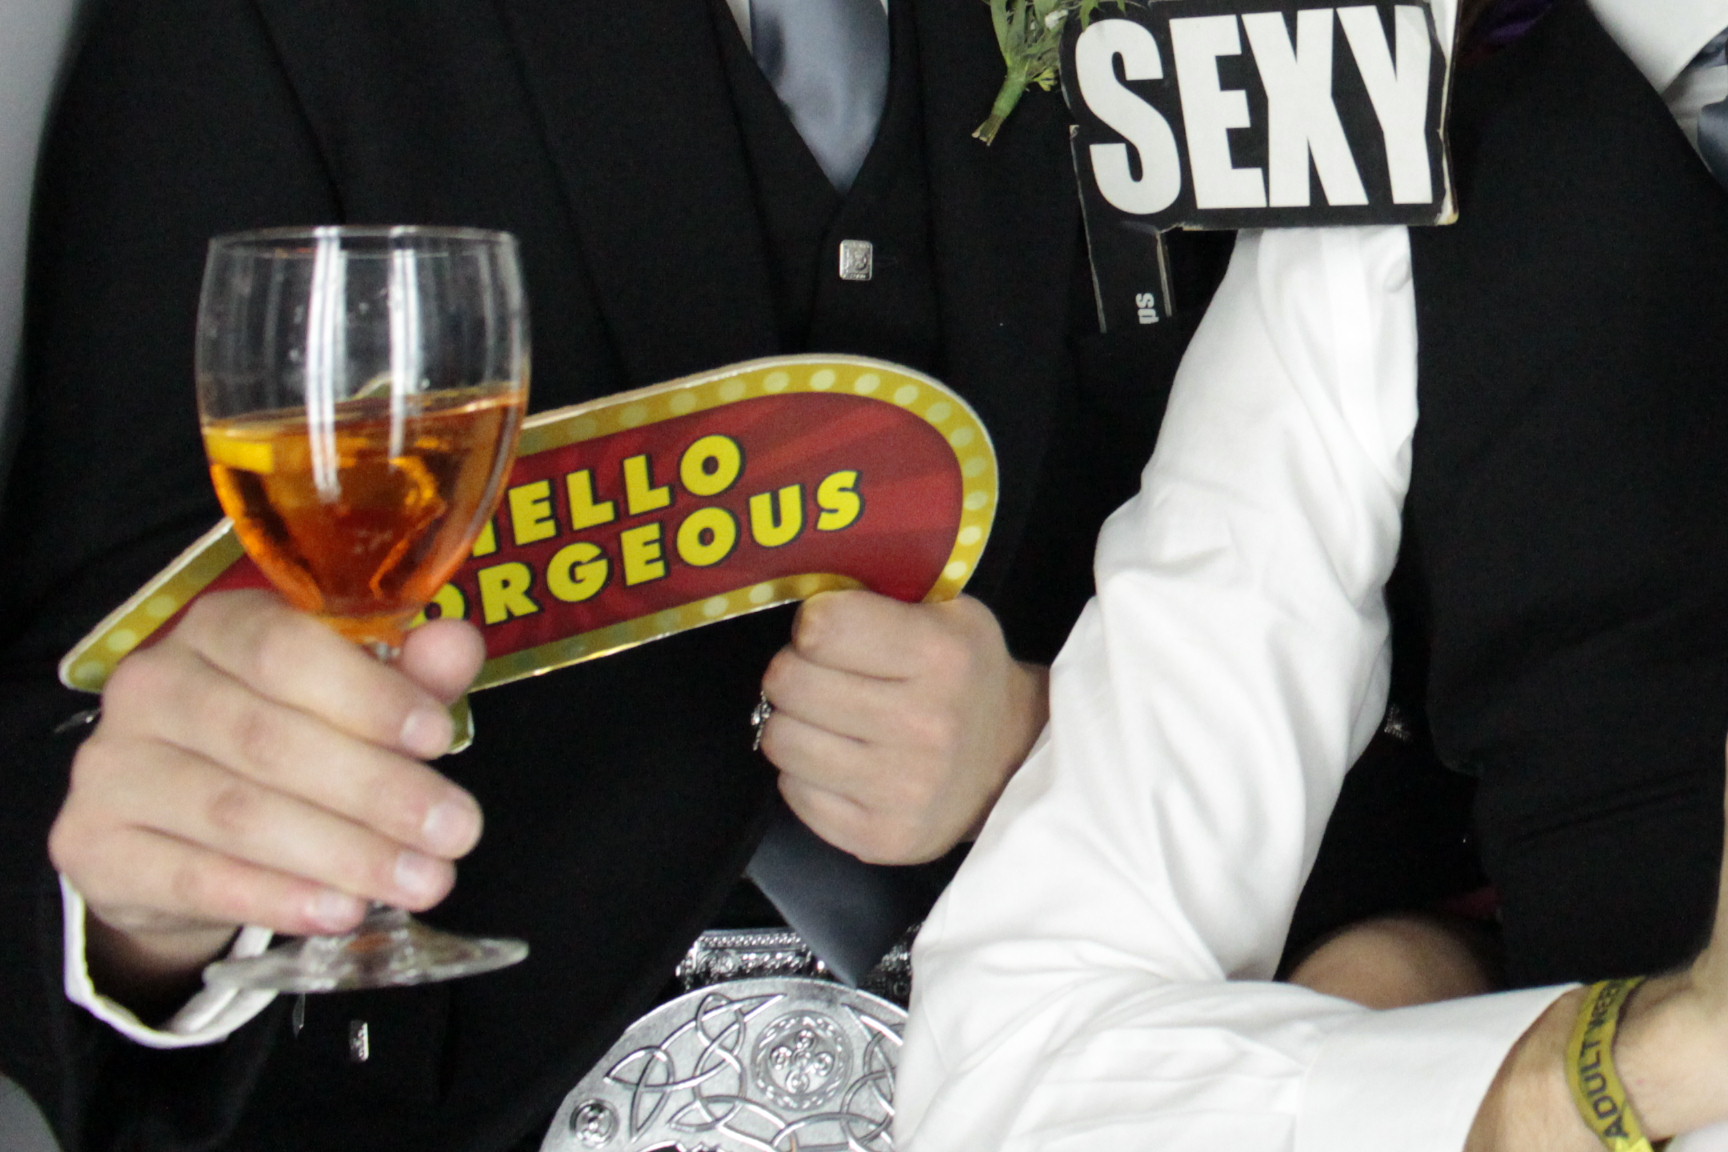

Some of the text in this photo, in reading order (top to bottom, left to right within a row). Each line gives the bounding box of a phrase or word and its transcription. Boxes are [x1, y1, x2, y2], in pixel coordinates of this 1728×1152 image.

[1075, 4, 1433, 215] SEXY
[409, 469, 864, 628] ORGEOUS
[1578, 1038, 1630, 1139] ADULT
